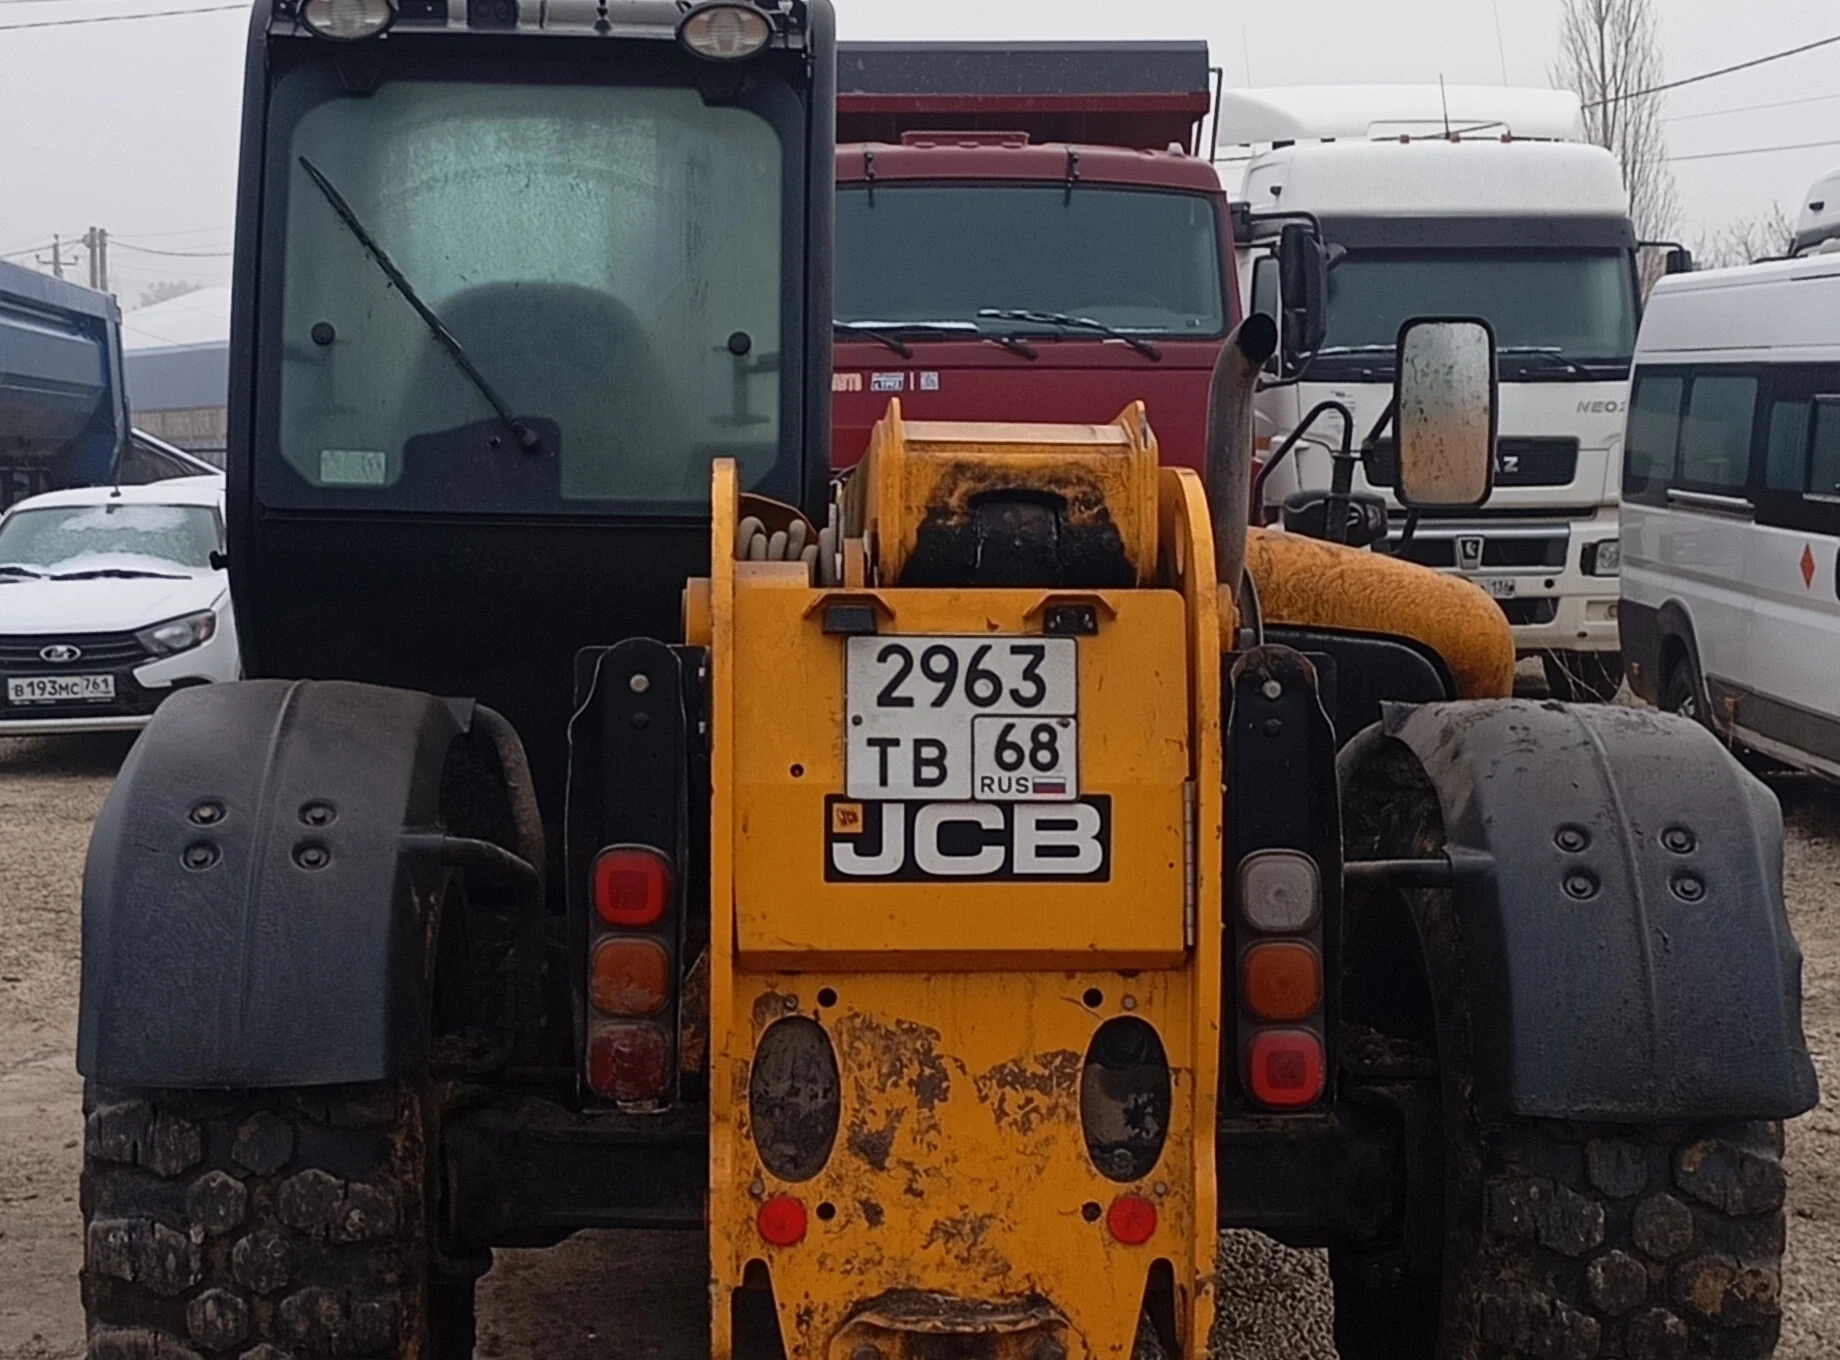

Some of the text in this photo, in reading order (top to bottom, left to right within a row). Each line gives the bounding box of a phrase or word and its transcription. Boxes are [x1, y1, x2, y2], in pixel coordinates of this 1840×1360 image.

[876, 644, 1046, 707] 2963
[994, 723, 1059, 772] 68
[980, 776, 1029, 794] RUS
[832, 803, 1103, 875] JCB
